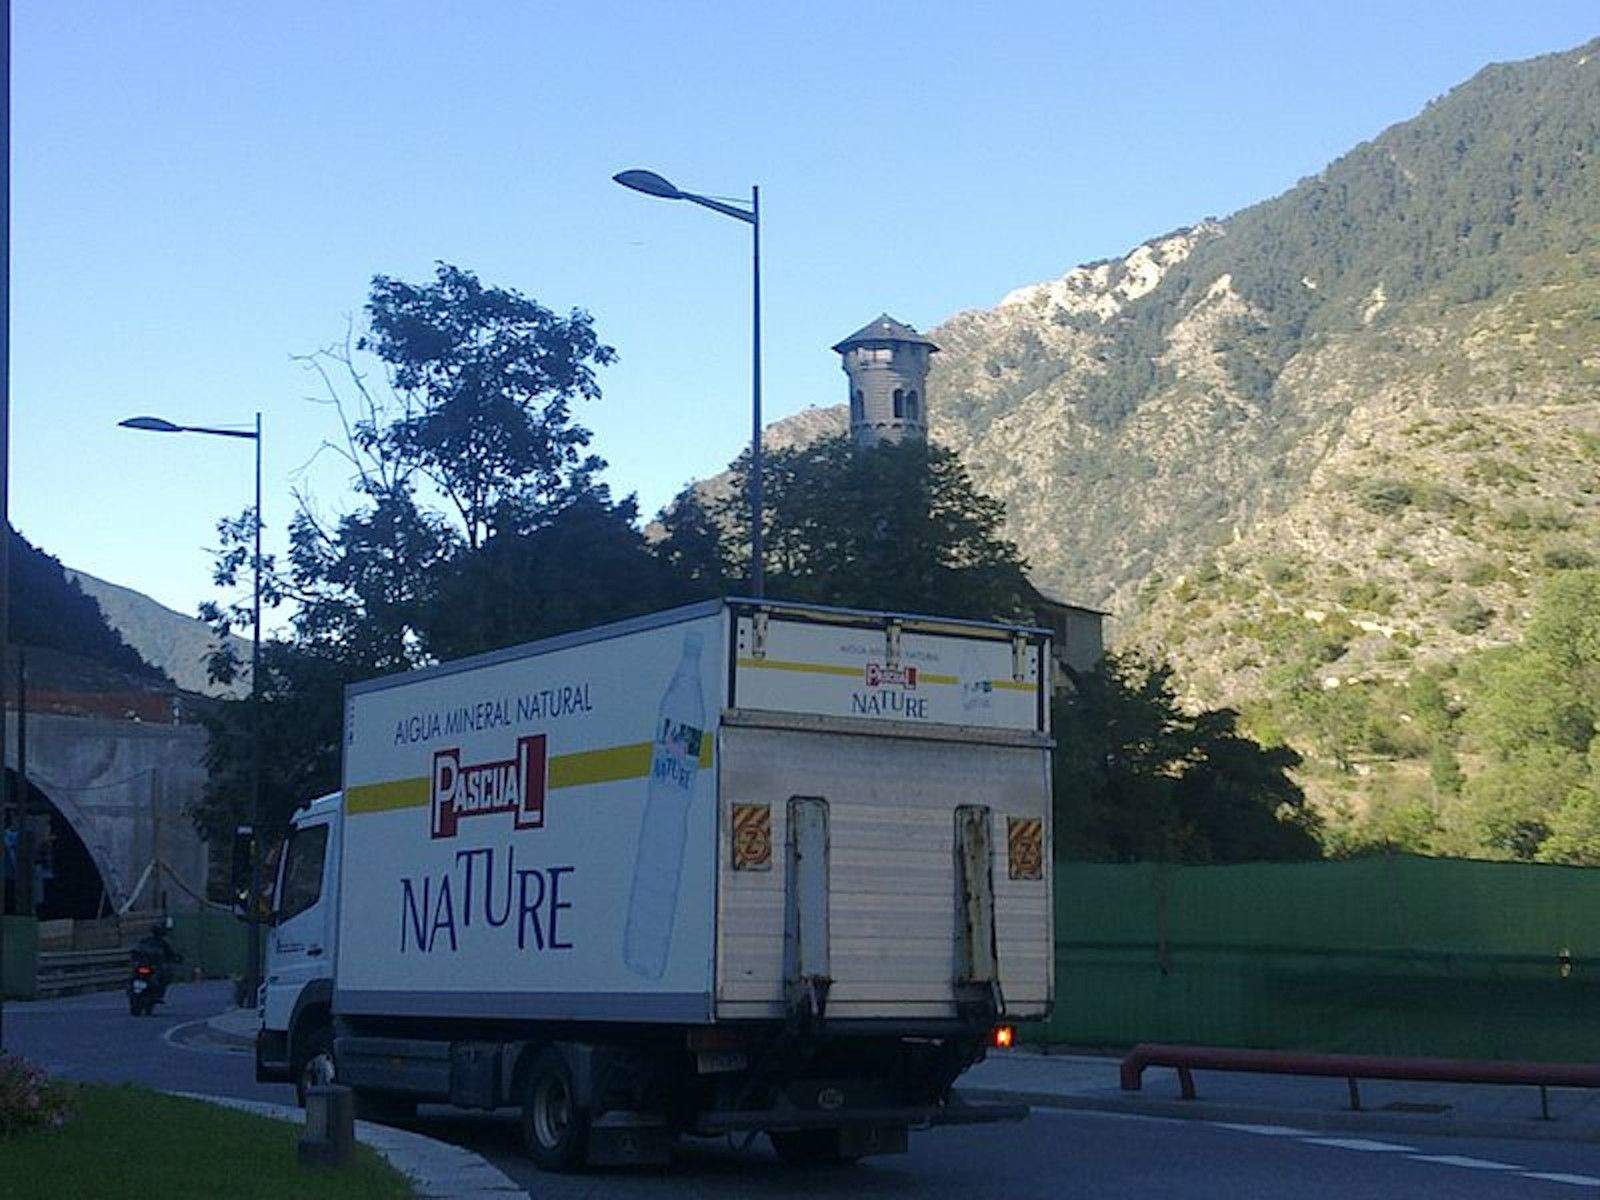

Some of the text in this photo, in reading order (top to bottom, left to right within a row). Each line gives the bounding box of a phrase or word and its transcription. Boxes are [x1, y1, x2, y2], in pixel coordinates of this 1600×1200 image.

[394, 708, 442, 747] AIGUA
[444, 697, 512, 735] MINERAL
[516, 682, 593, 722] NATURAL
[852, 690, 929, 720] NATURE
[432, 735, 546, 839] PASCUAL
[400, 845, 576, 954] NATURE
